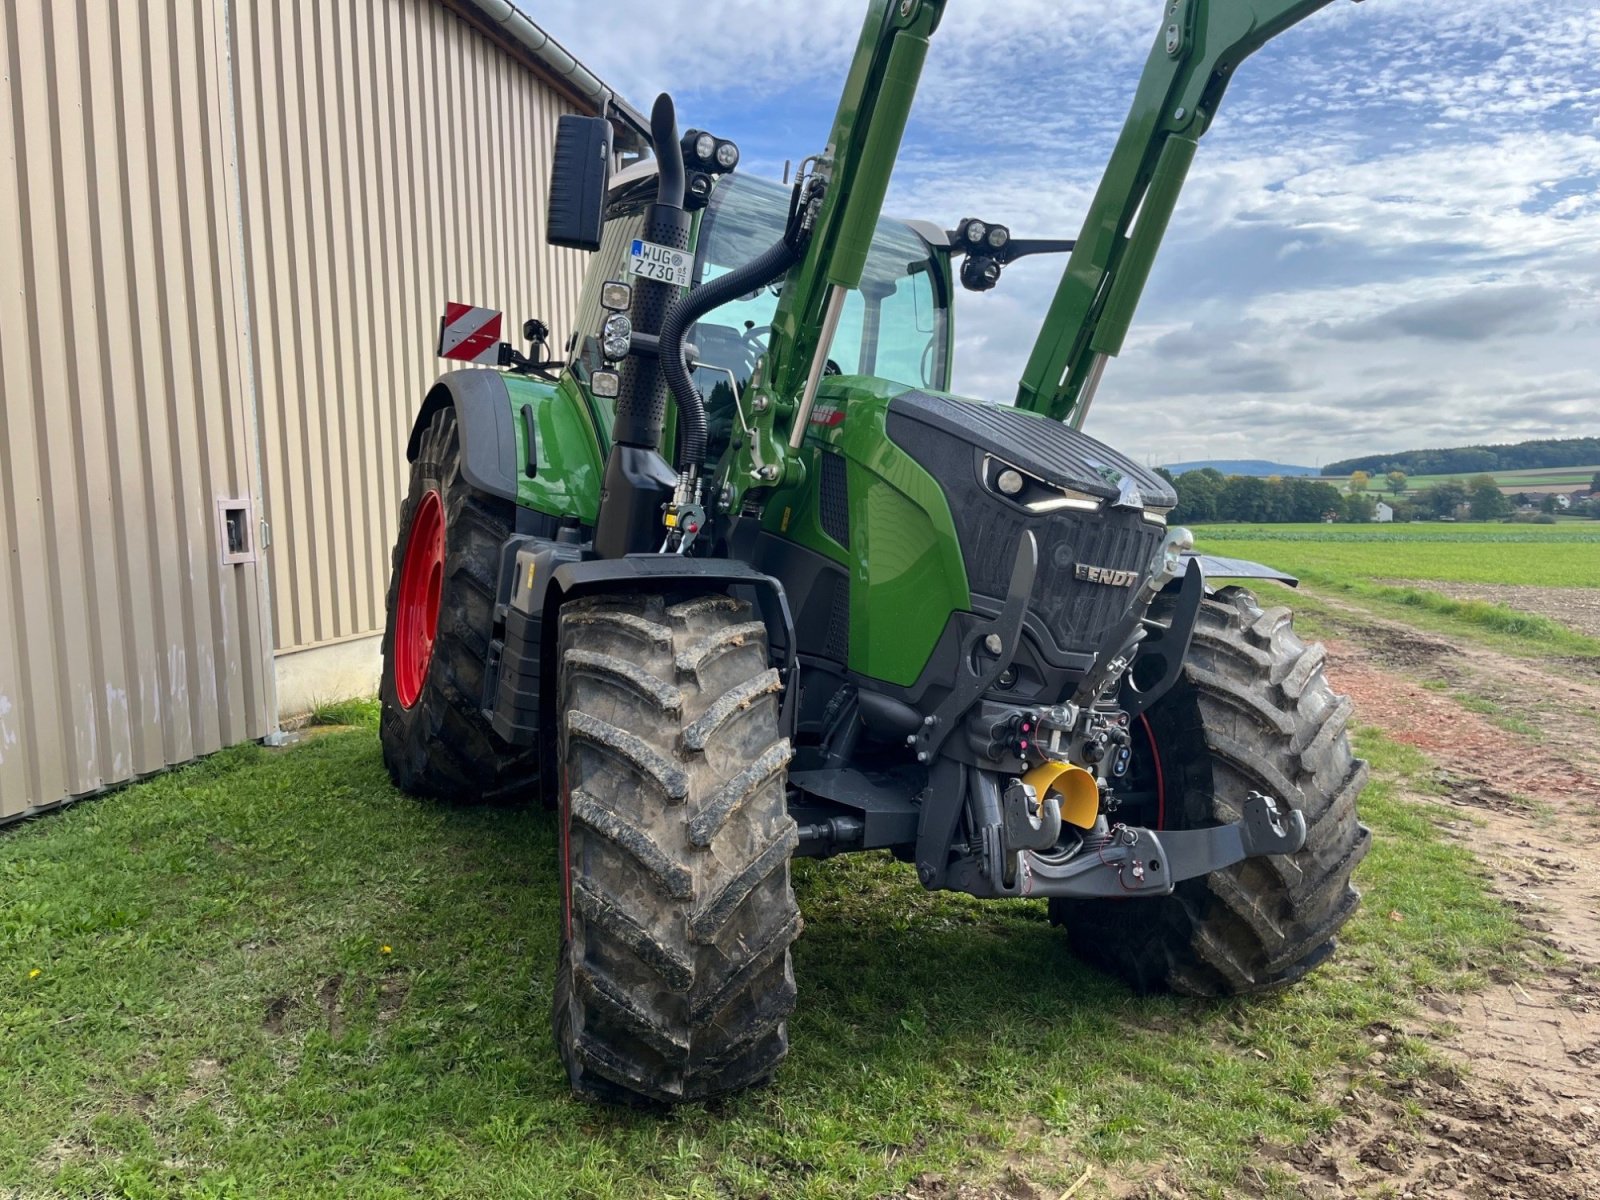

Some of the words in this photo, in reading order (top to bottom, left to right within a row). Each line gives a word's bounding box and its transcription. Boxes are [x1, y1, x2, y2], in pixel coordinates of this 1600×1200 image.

[643, 244, 671, 264] WUG
[634, 259, 645, 274] Z
[647, 262, 674, 281] 730
[1073, 562, 1139, 588] FENDT
